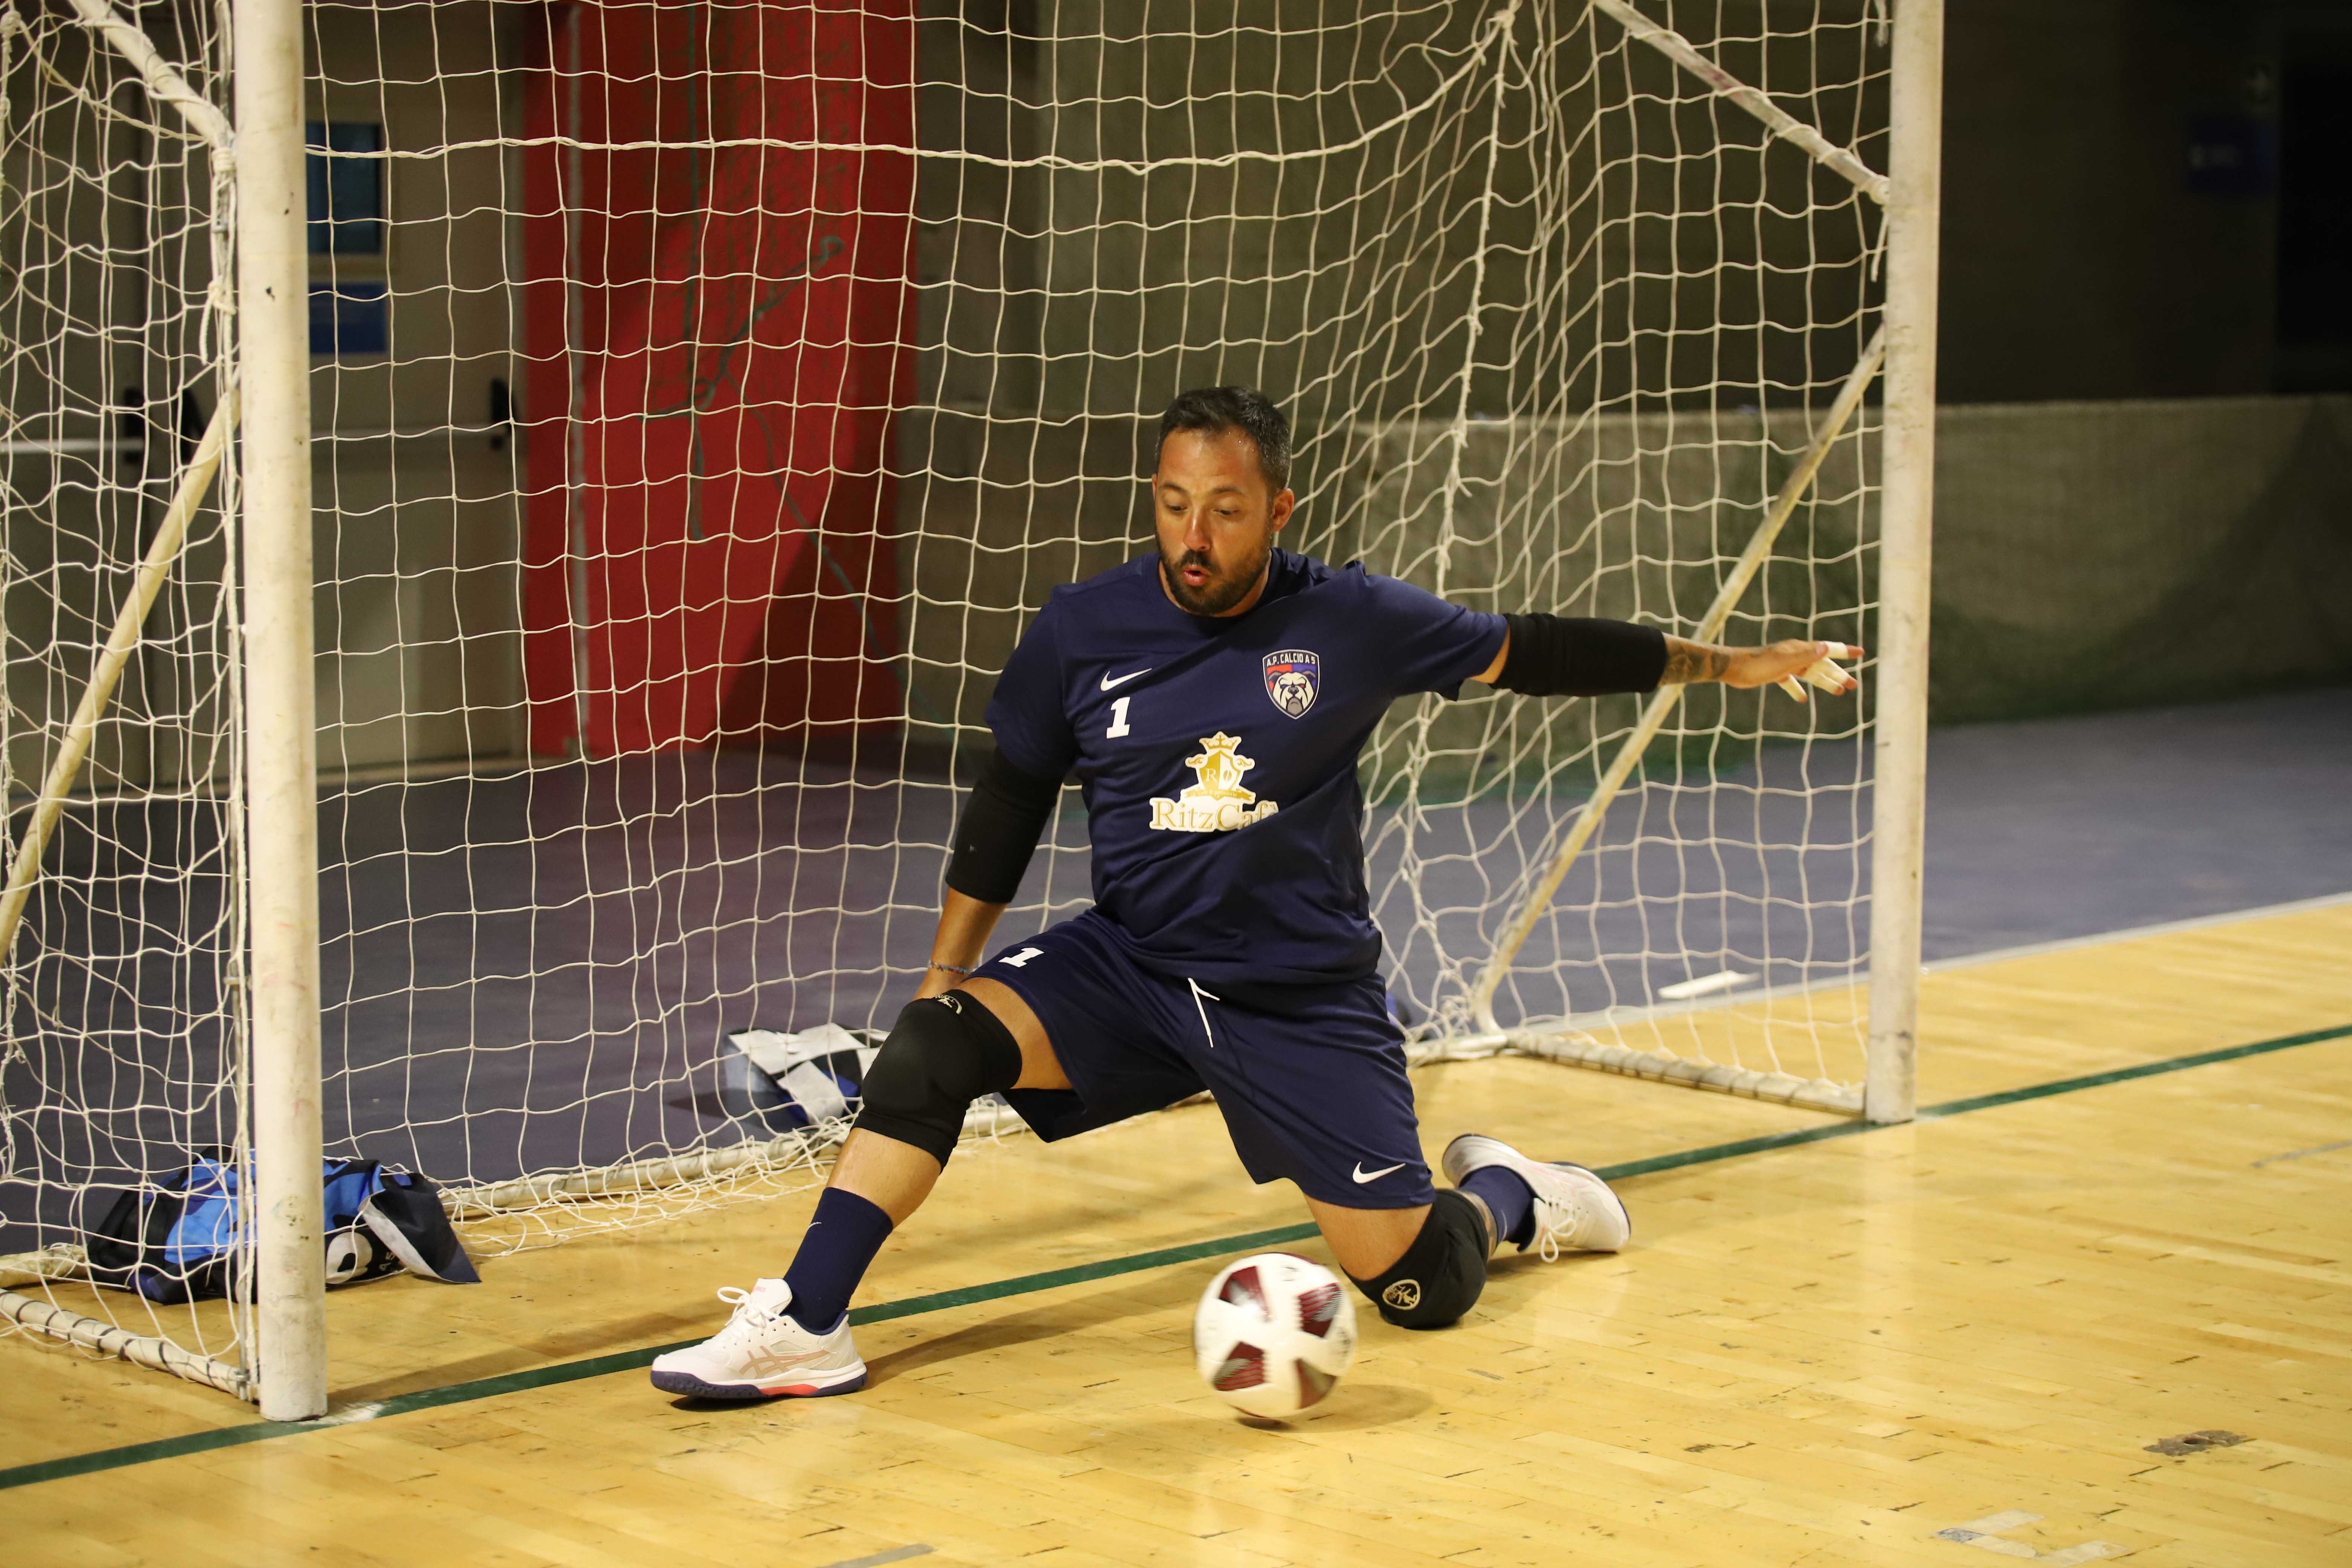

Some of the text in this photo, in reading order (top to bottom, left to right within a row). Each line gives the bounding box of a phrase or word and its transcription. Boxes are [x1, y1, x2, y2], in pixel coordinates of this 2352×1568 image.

[1267, 653, 1315, 666] A.P. CALCIO A 5
[1106, 697, 1130, 739] 1
[998, 947, 1044, 968] 1
